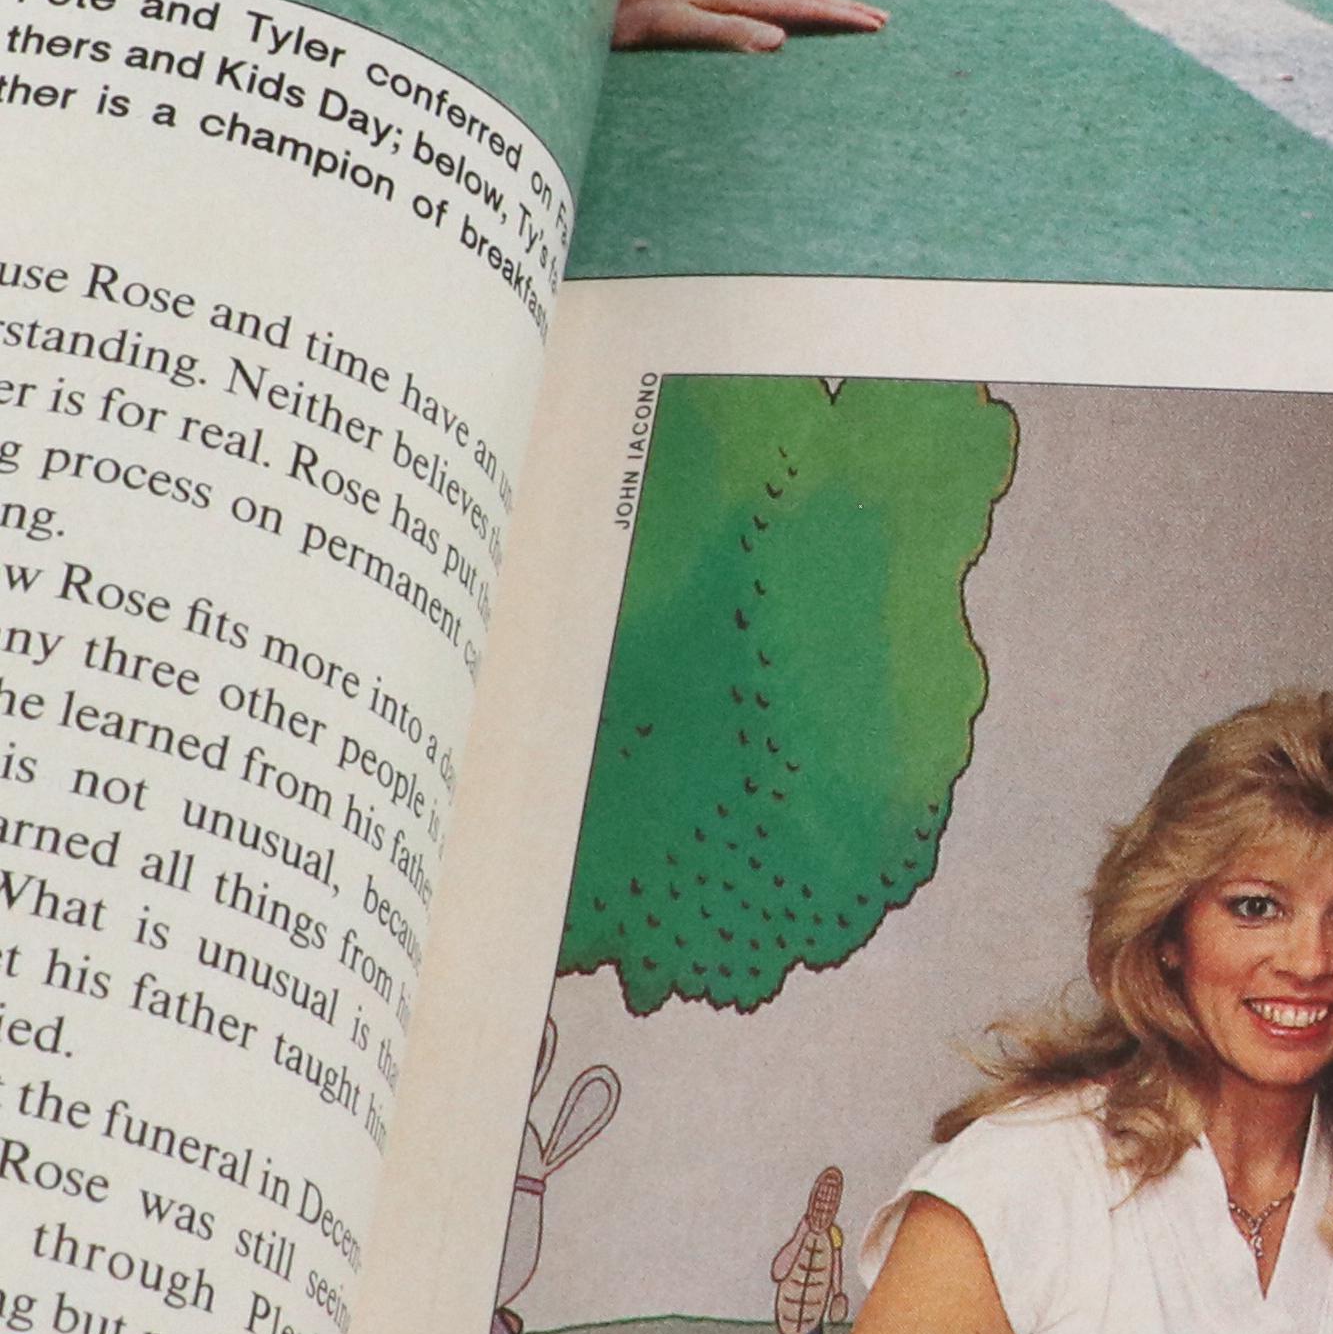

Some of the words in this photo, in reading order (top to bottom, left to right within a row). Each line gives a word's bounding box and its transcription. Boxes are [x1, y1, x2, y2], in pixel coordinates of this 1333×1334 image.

[7, 24, 112, 62] thers
[124, 45, 205, 80] and
[215, 56, 306, 108] Kids
[318, 87, 403, 155] Day;
[413, 130, 507, 225] below,
[519, 202, 548, 269] Ty's
[97, 85, 131, 117] is
[152, 102, 176, 127] a
[200, 112, 395, 201] champion
[412, 194, 448, 227] of
[247, 11, 346, 68] Tyler
[366, 62, 523, 172] conferred
[531, 170, 551, 211] on
[82, 263, 195, 318] Rose
[209, 303, 292, 350] and
[305, 331, 390, 393] time
[400, 372, 470, 448] have
[473, 439, 498, 483] an
[614, 471, 640, 530] JOHN
[627, 372, 659, 459] IACONO
[38, 447, 213, 509] process
[231, 496, 283, 536] on
[298, 522, 463, 647] permanent
[48, 376, 85, 416] is
[97, 387, 168, 433] for
[178, 415, 271, 468] real.
[285, 440, 382, 515] Rose
[389, 493, 441, 555] has
[442, 544, 479, 597] put
[55, 562, 171, 623] Rose
[183, 597, 249, 650] fits
[260, 634, 360, 699] more
[368, 676, 423, 745] into
[426, 733, 438, 765] a
[0, 741, 38, 784] is
[69, 768, 149, 811] not
[182, 798, 340, 898] unusual,
[42, 947, 111, 1000] his
[129, 972, 258, 1051] father
[273, 1032, 361, 1117] taught
[0, 1137, 110, 1203] Rose
[139, 1188, 216, 1241] was
[235, 1228, 296, 1283] still
